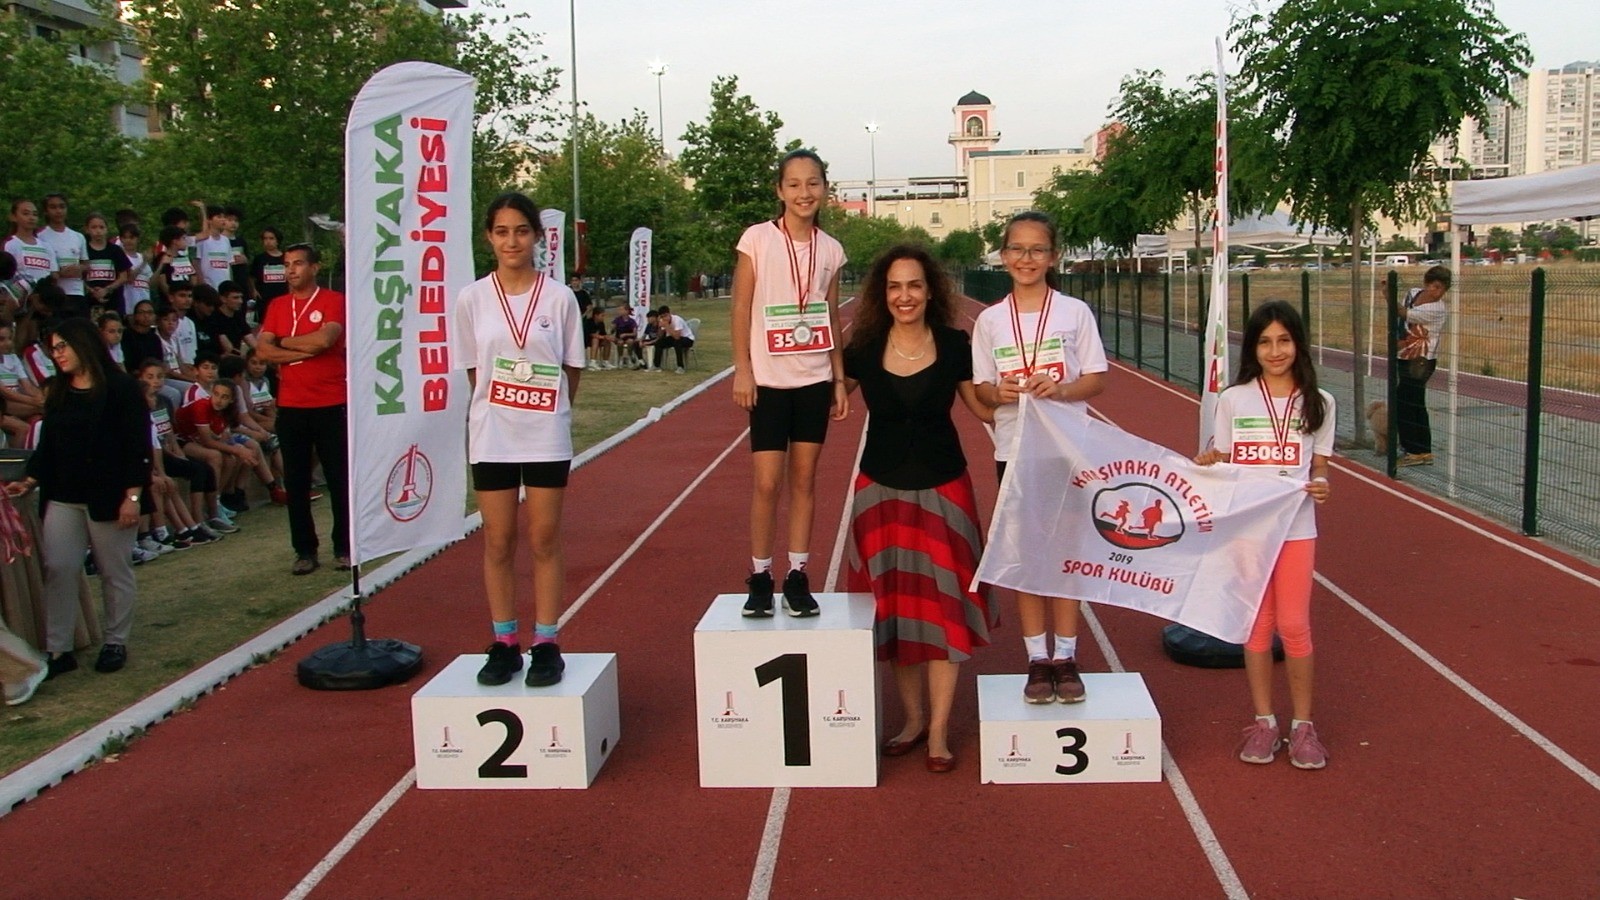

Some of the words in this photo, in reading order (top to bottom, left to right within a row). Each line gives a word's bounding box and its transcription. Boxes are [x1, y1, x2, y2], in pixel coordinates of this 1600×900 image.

[374, 114, 412, 415] KARŞIYAKA
[410, 117, 449, 412] BELEDİYESİ
[773, 330, 824, 348] 3571
[494, 385, 552, 407] 35085
[1236, 445, 1296, 461] 35068
[1062, 560, 1104, 578] SPOR
[1108, 567, 1175, 595] KULÜBÜ
[1108, 552, 1134, 565] 2019
[754, 653, 811, 766] 1
[476, 708, 528, 778] 2
[1055, 727, 1089, 775] 3
